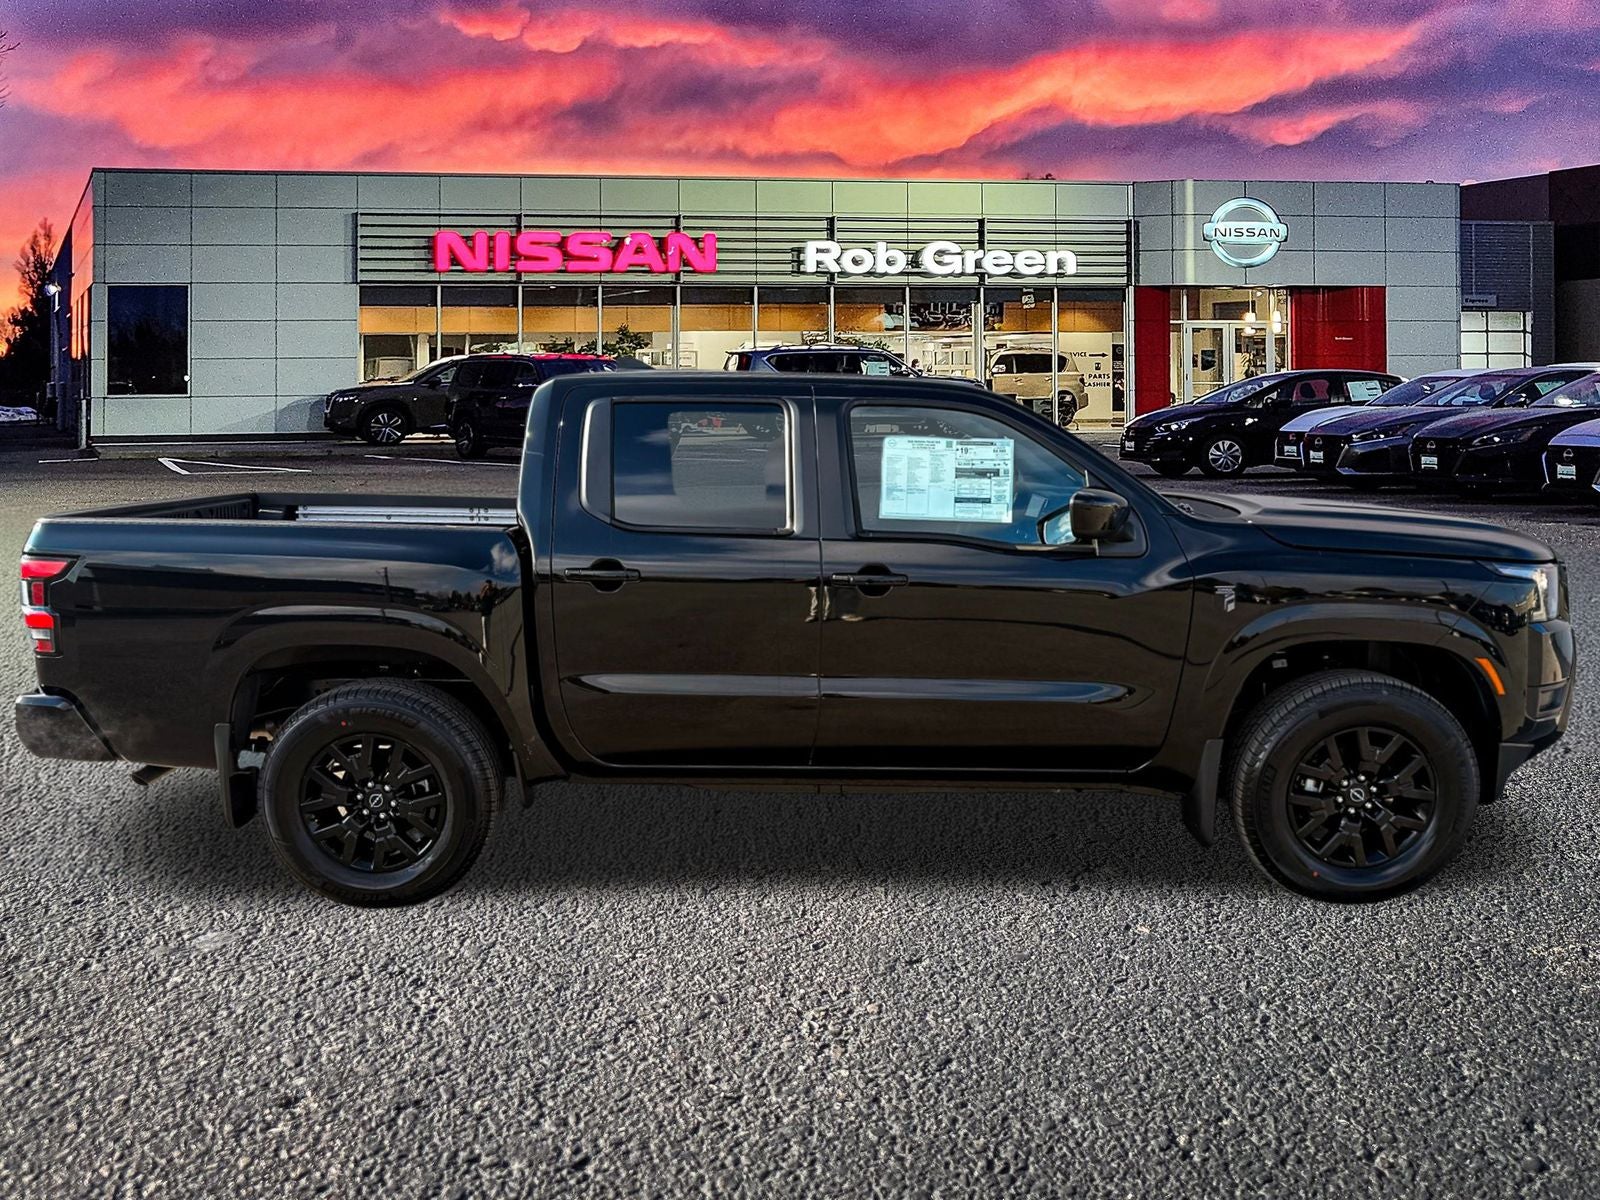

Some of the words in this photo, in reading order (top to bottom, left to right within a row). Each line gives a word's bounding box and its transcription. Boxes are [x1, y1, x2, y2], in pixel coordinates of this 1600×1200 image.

[1214, 227, 1280, 238] NISSAN
[434, 231, 718, 273] NISSAN
[804, 240, 907, 275] Rob
[921, 240, 1078, 275] Green
